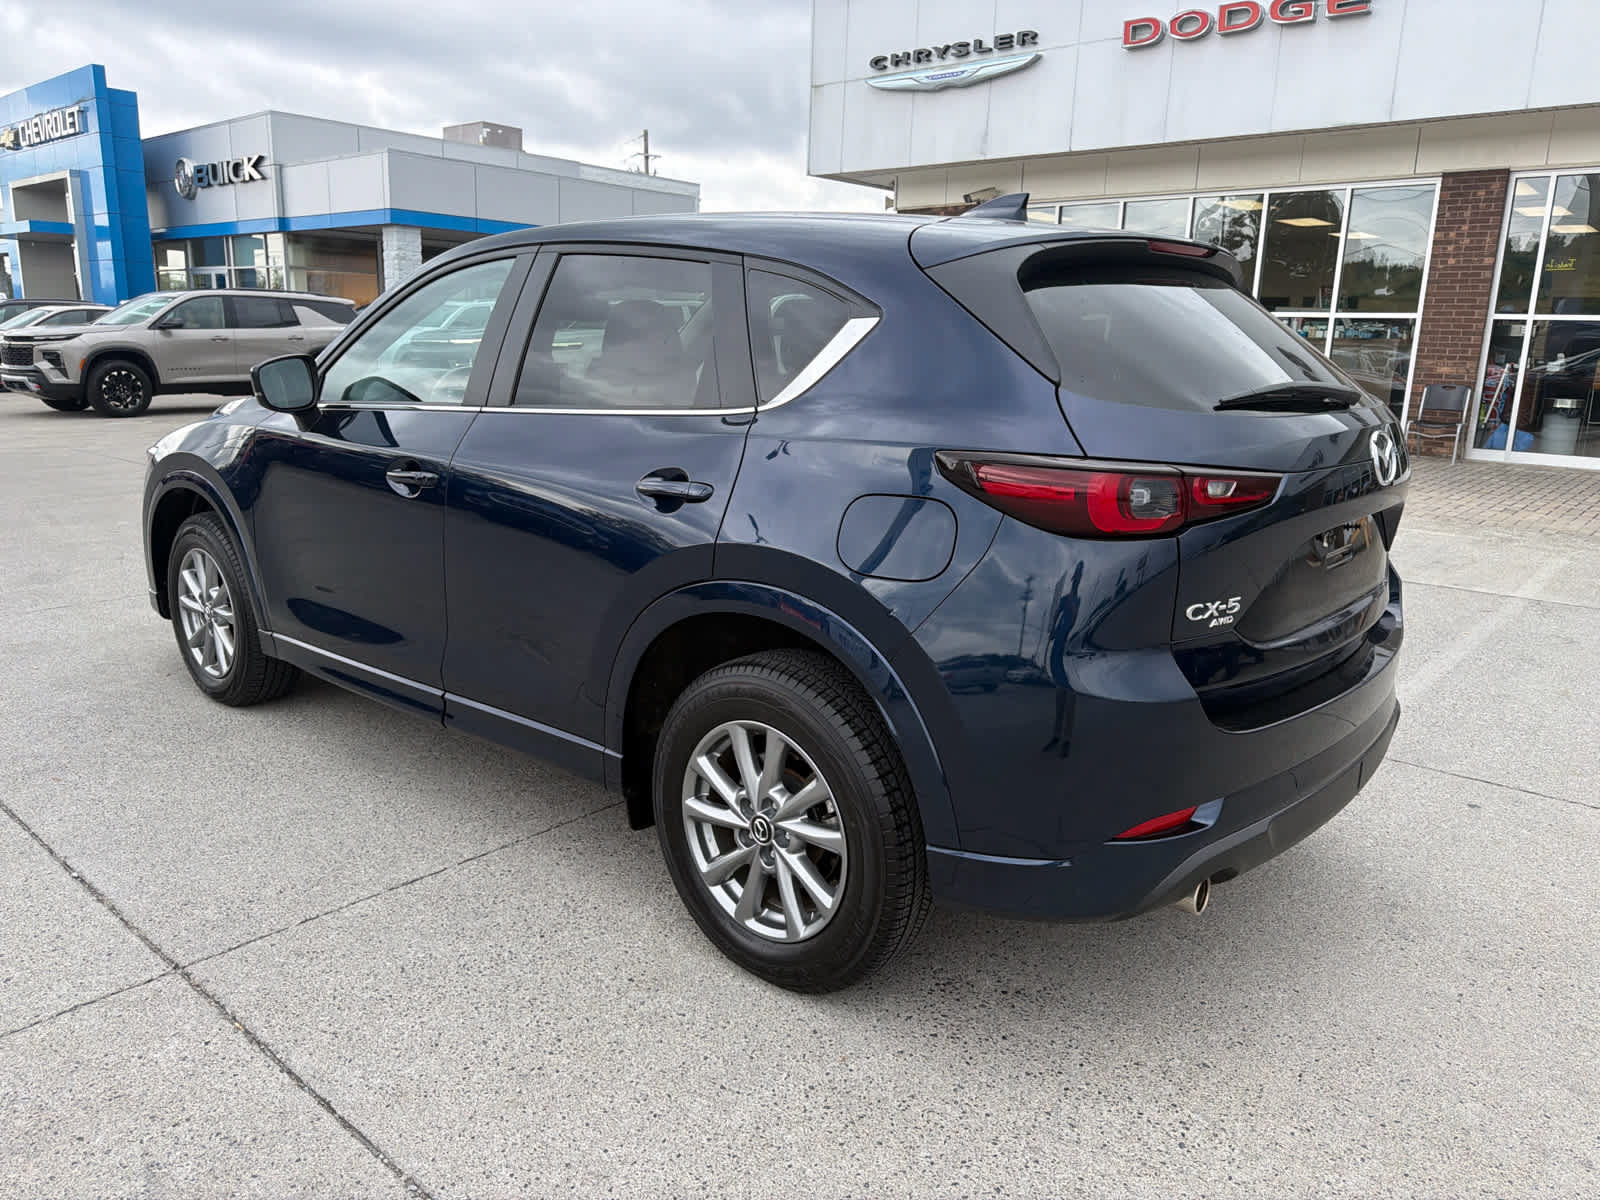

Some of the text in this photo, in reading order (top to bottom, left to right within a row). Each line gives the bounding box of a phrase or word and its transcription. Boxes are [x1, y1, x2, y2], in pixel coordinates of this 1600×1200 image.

[869, 30, 1039, 71] CHRYSLER
[18, 105, 83, 147] CHEVROLET
[193, 154, 264, 188] BUICK
[1186, 596, 1242, 621] CX-5
[1209, 615, 1234, 628] AWD
